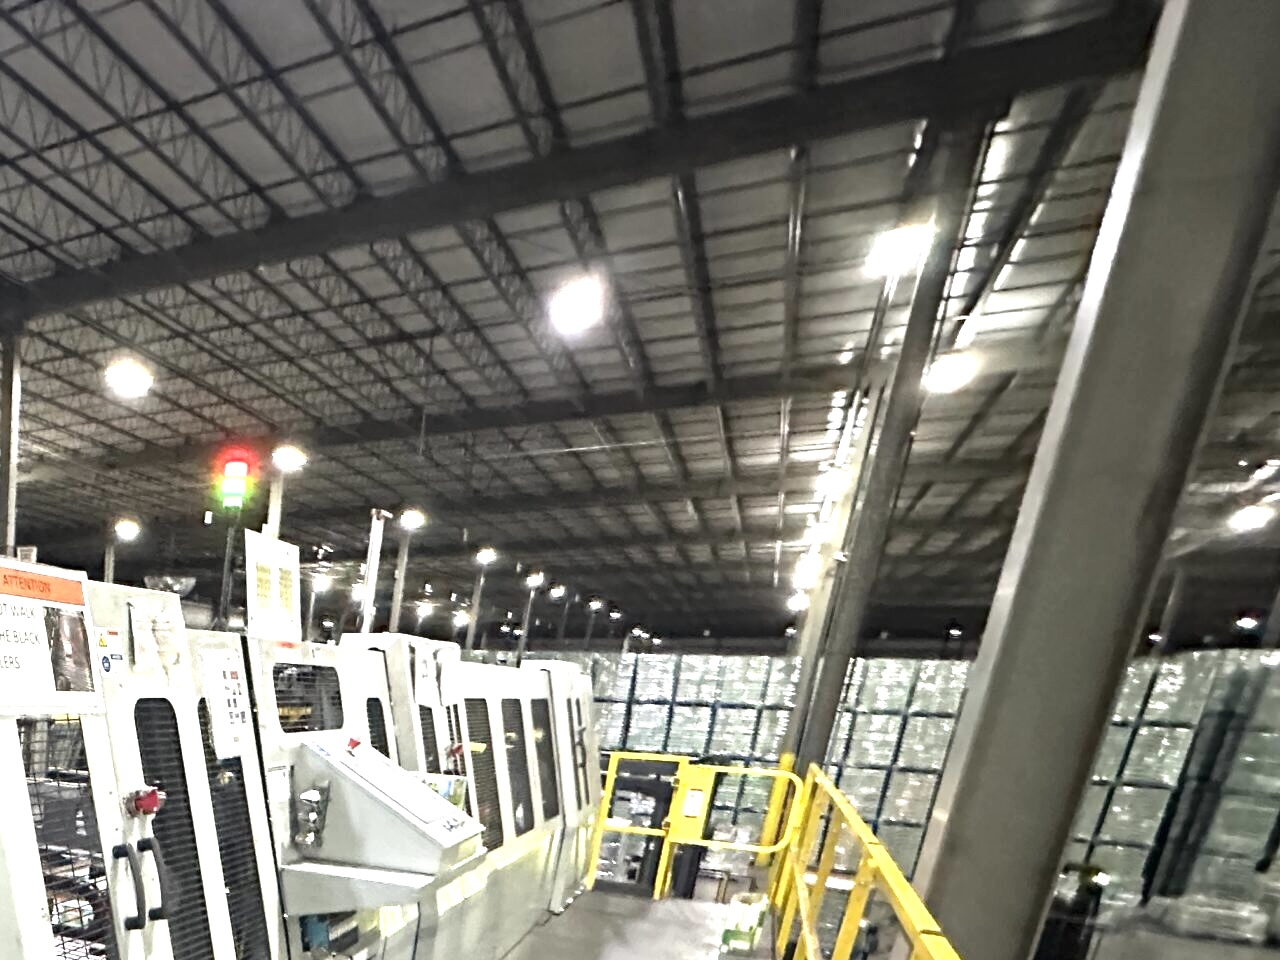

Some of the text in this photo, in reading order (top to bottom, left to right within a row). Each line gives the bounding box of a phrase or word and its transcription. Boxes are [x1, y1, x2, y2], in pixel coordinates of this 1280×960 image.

[3, 574, 51, 593] ATTENTION
[10, 605, 36, 619] WALK
[13, 631, 40, 645] BLACK
